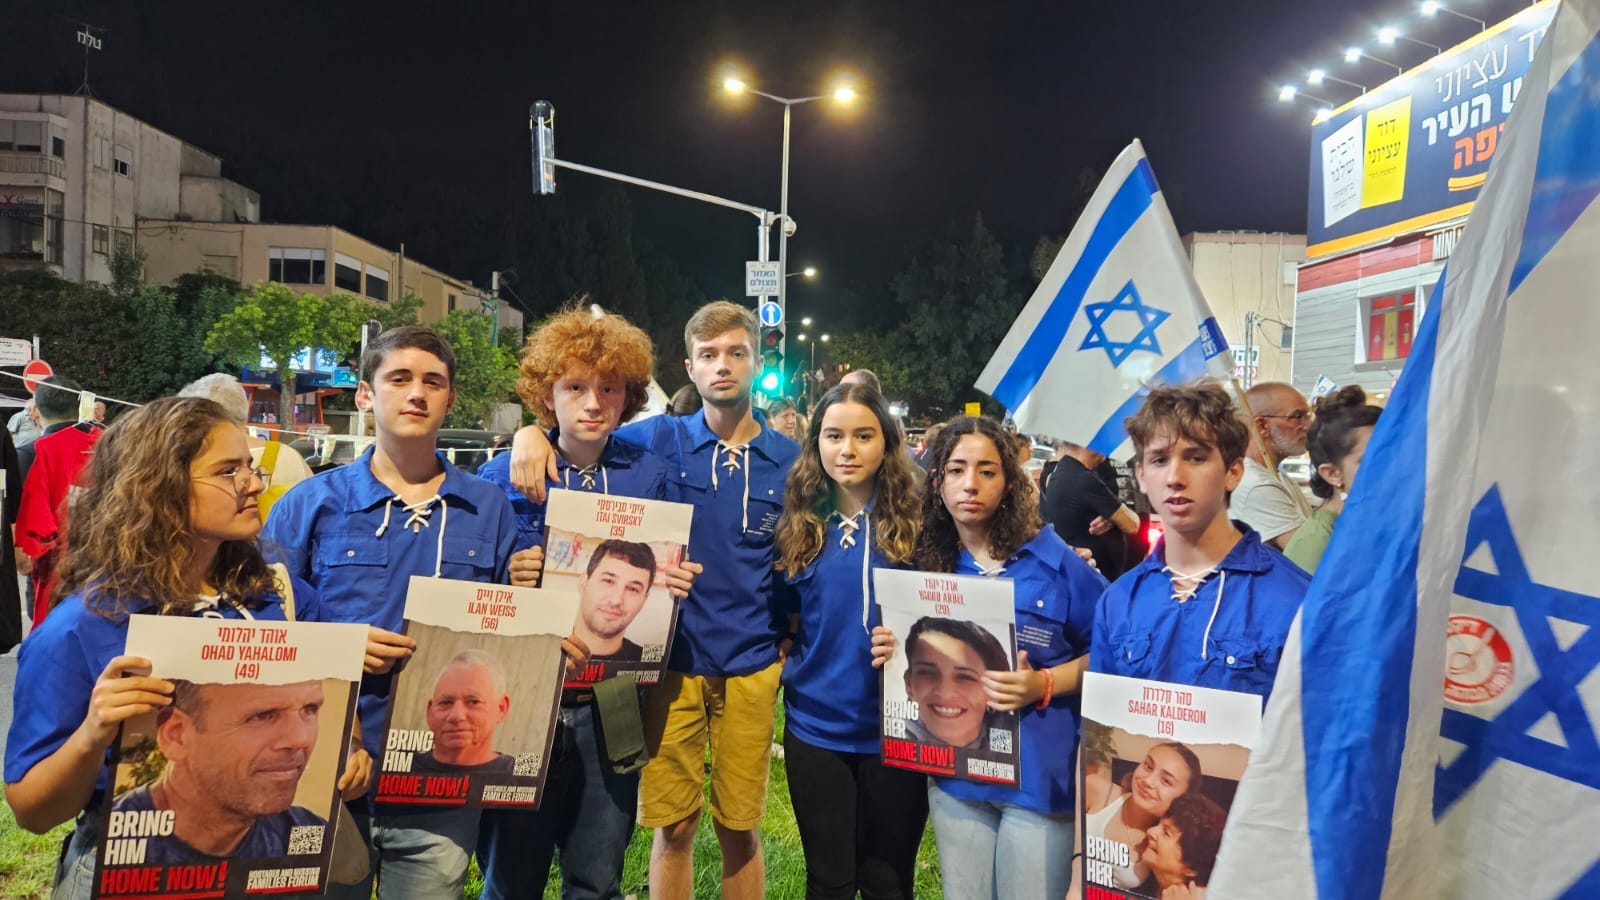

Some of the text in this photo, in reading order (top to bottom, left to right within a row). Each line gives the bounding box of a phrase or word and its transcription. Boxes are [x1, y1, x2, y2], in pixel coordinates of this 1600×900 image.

[1435, 43, 1508, 102] עציוני
[1377, 118, 1396, 137] דוד
[1422, 93, 1492, 145] העיר
[1368, 141, 1401, 164] עציוני
[1432, 230, 1456, 260] MINI
[596, 511, 643, 527] ITAI SVIRSKY
[476, 588, 514, 604] אילן וייס
[467, 602, 517, 618] ILAN WEISS
[217, 626, 288, 644] אוהד יהלומי
[481, 617, 499, 631] (56)
[201, 645, 298, 662] OHAD YAHALOMI
[234, 663, 260, 680] (49)
[1174, 691, 1192, 705] סהר
[884, 700, 919, 721] BRING
[1128, 700, 1206, 724] SAHAR KALDERON
[884, 718, 907, 739] HER
[1157, 719, 1175, 736] (16)
[385, 728, 435, 752] BRING
[382, 751, 414, 773] HIM
[884, 738, 917, 761] HOME
[920, 745, 955, 769] NOW!
[378, 773, 470, 798] HOME NOW!
[107, 809, 176, 838] BRING
[103, 838, 148, 866] HIM
[1086, 835, 1130, 867] BRING
[100, 860, 228, 894] HOME NOW!
[247, 875, 319, 890] FAMILIES FORUM
[1086, 859, 1114, 888] HER
